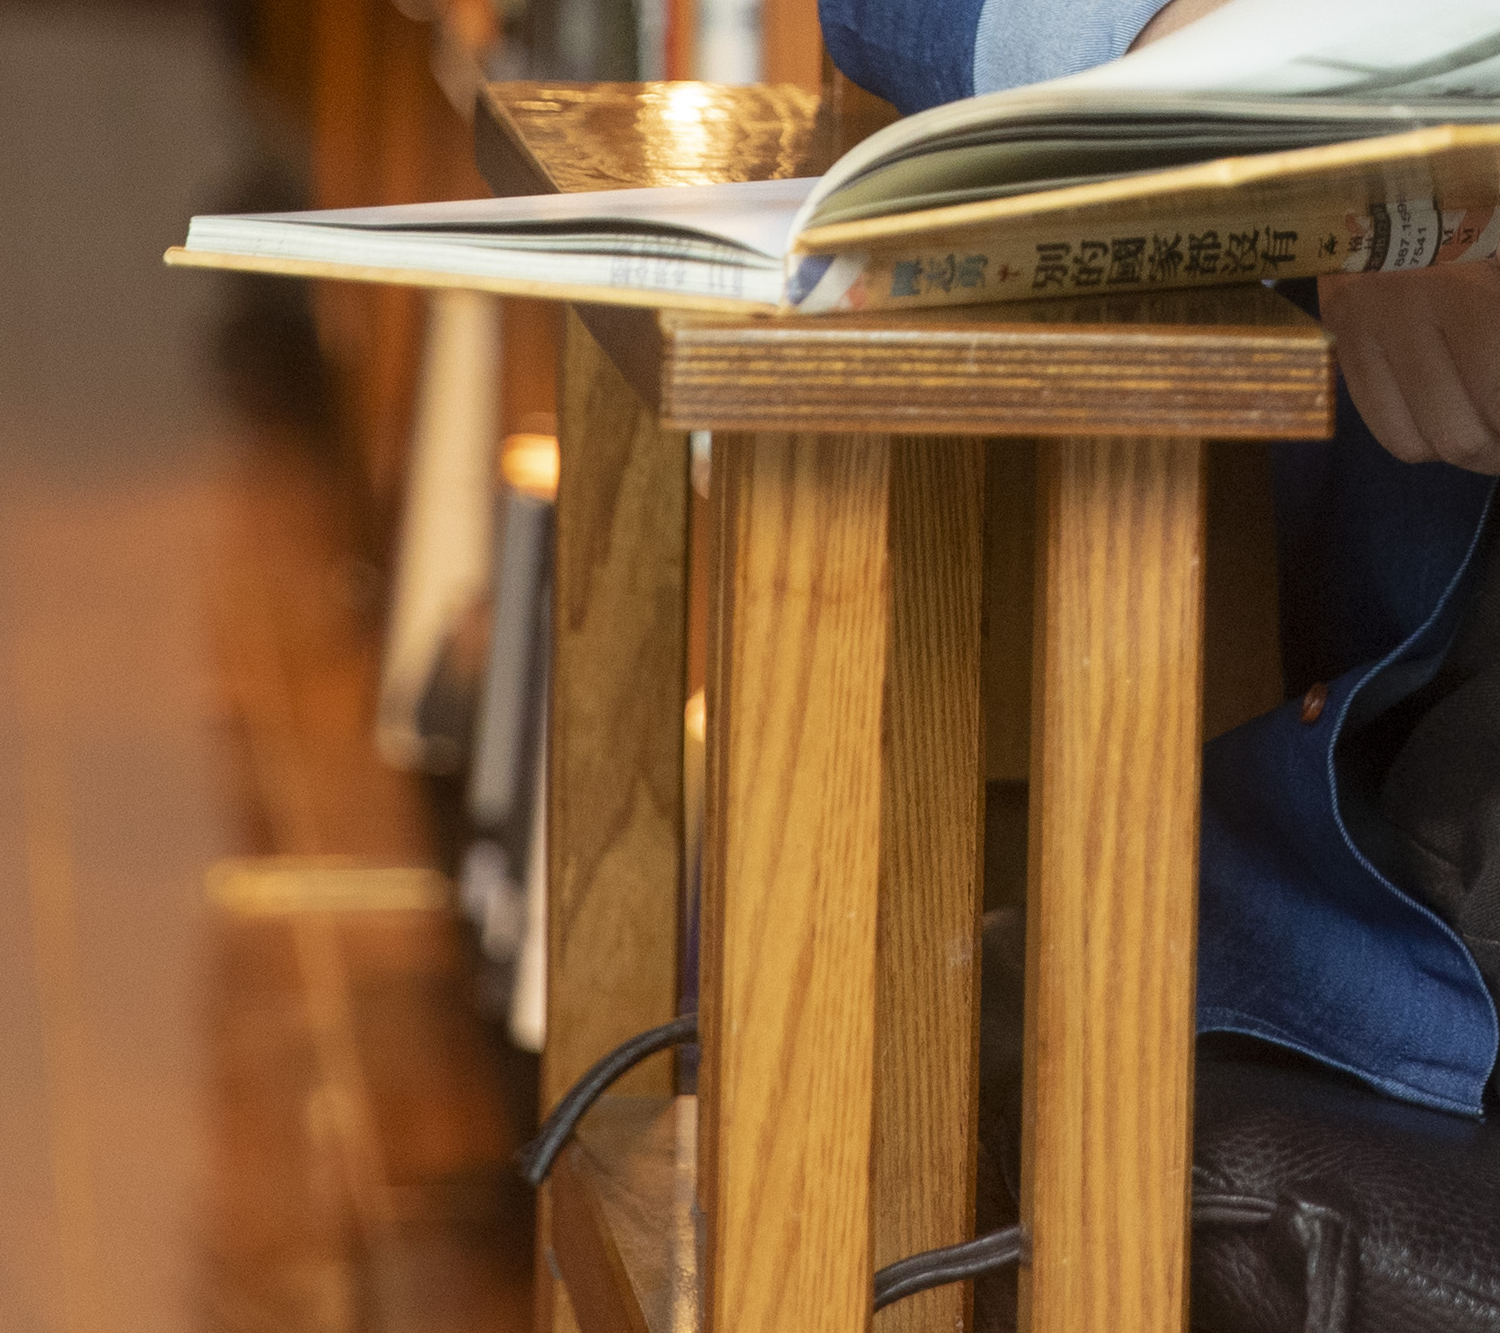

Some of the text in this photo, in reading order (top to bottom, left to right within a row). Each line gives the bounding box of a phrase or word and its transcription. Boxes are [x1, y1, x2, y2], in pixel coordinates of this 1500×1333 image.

[1032, 226, 1298, 290] 別的國家都沒有
[1408, 226, 1428, 265] 7541
